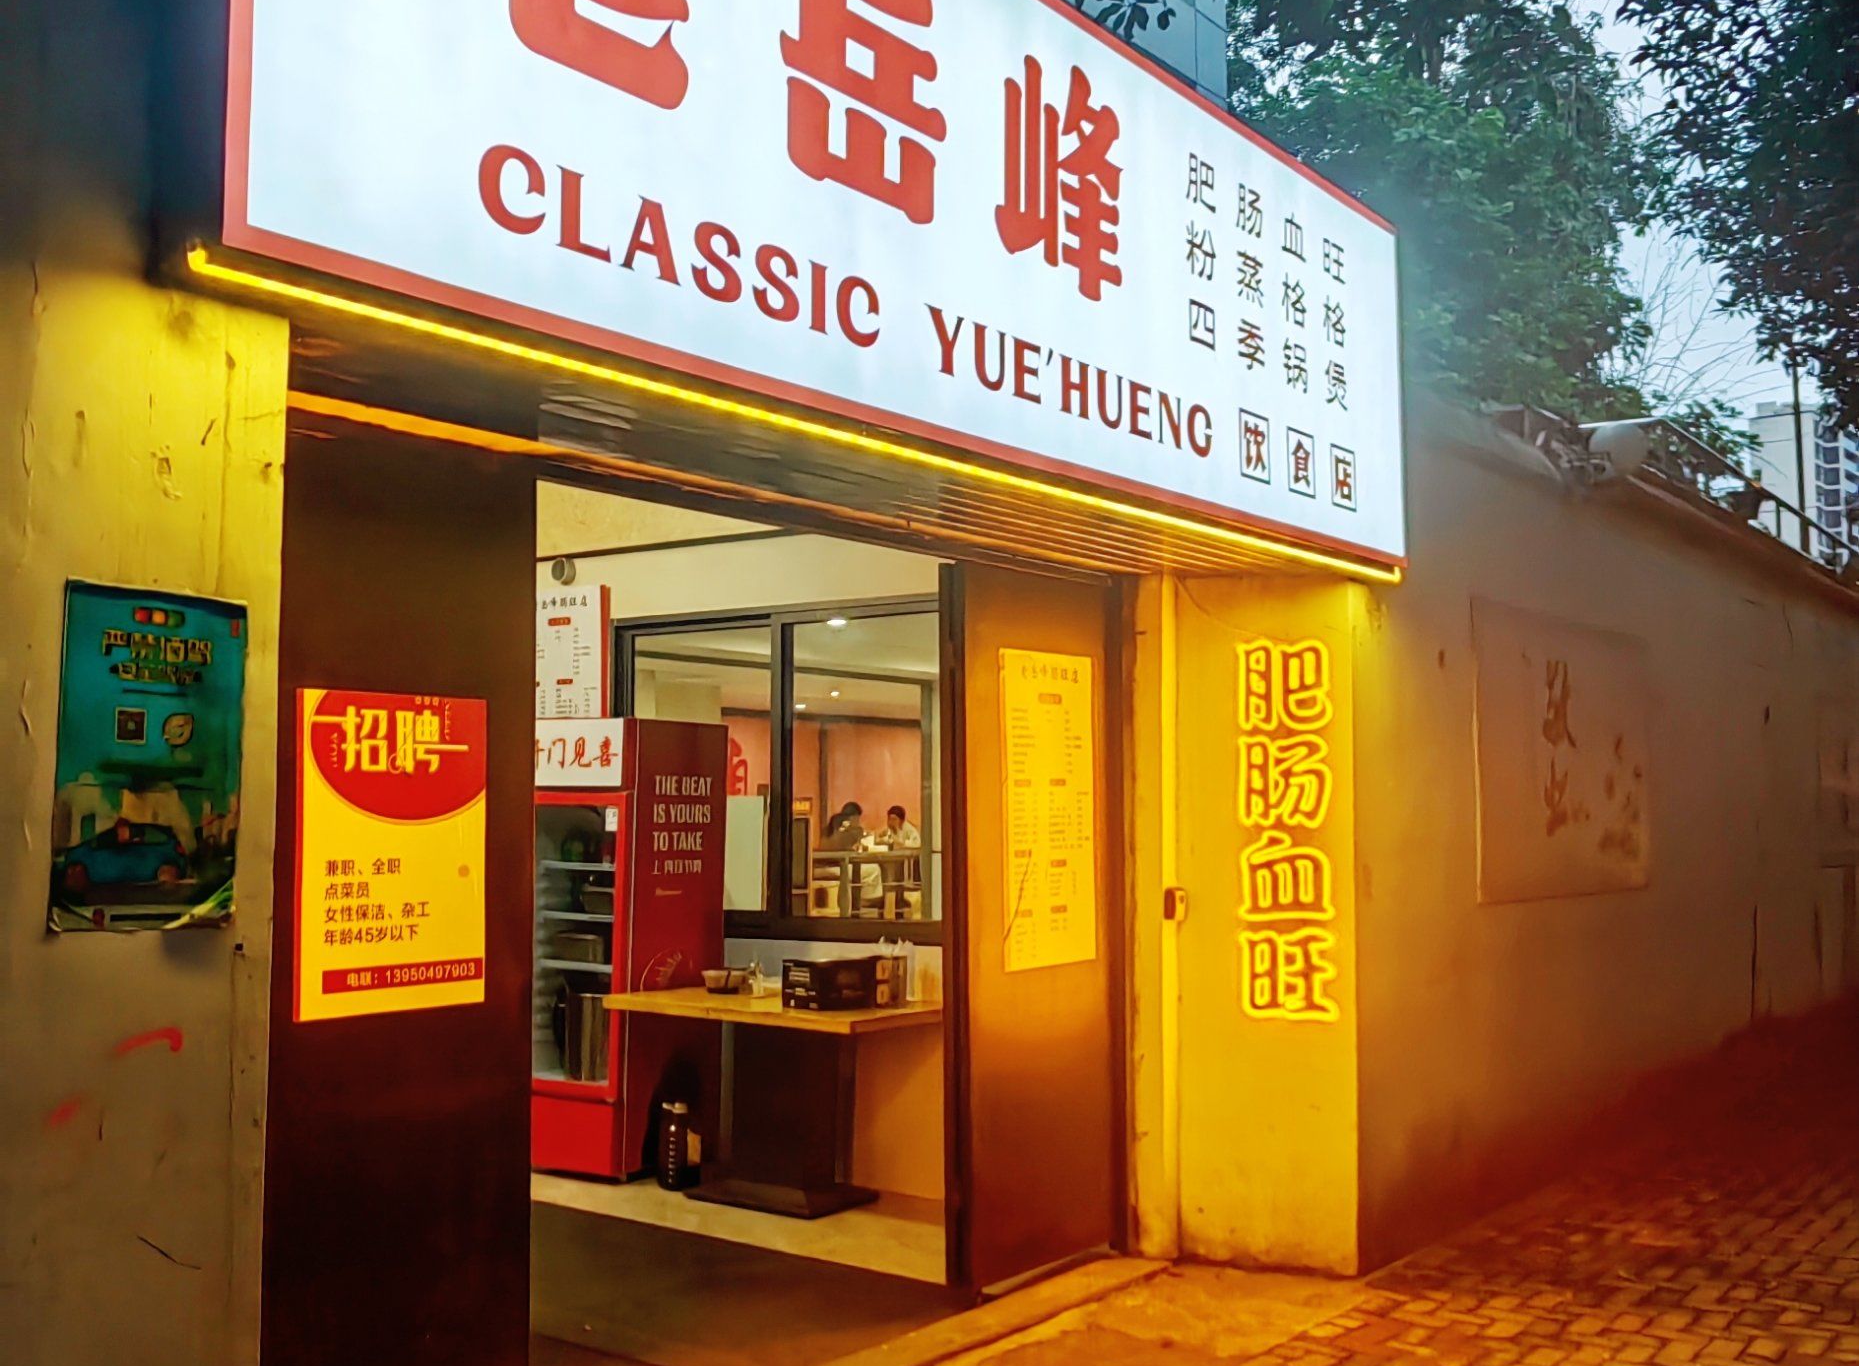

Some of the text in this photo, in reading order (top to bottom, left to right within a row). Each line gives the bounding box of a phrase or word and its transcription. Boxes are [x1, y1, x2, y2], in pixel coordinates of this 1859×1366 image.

[1186, 152, 1347, 285] 肥肠血旺
[478, 144, 1213, 458] CLASSIC YUE'HUENG
[1186, 219, 1346, 348] 粉蒸格格
[1188, 298, 1349, 411] 四季锅煲
[1242, 418, 1354, 503] 饮食店
[312, 705, 469, 774] 招聘
[655, 775, 679, 796] THE
[653, 803, 711, 824] IS YOURS
[1236, 638, 1340, 1023] 肥肠血旺
[652, 831, 703, 852] TO TAKE
[325, 858, 401, 877] 兼职、全职
[324, 882, 370, 901] 点菜员
[324, 901, 430, 923] 女性保洁、杂工
[324, 924, 419, 946] 年龄45岁以下
